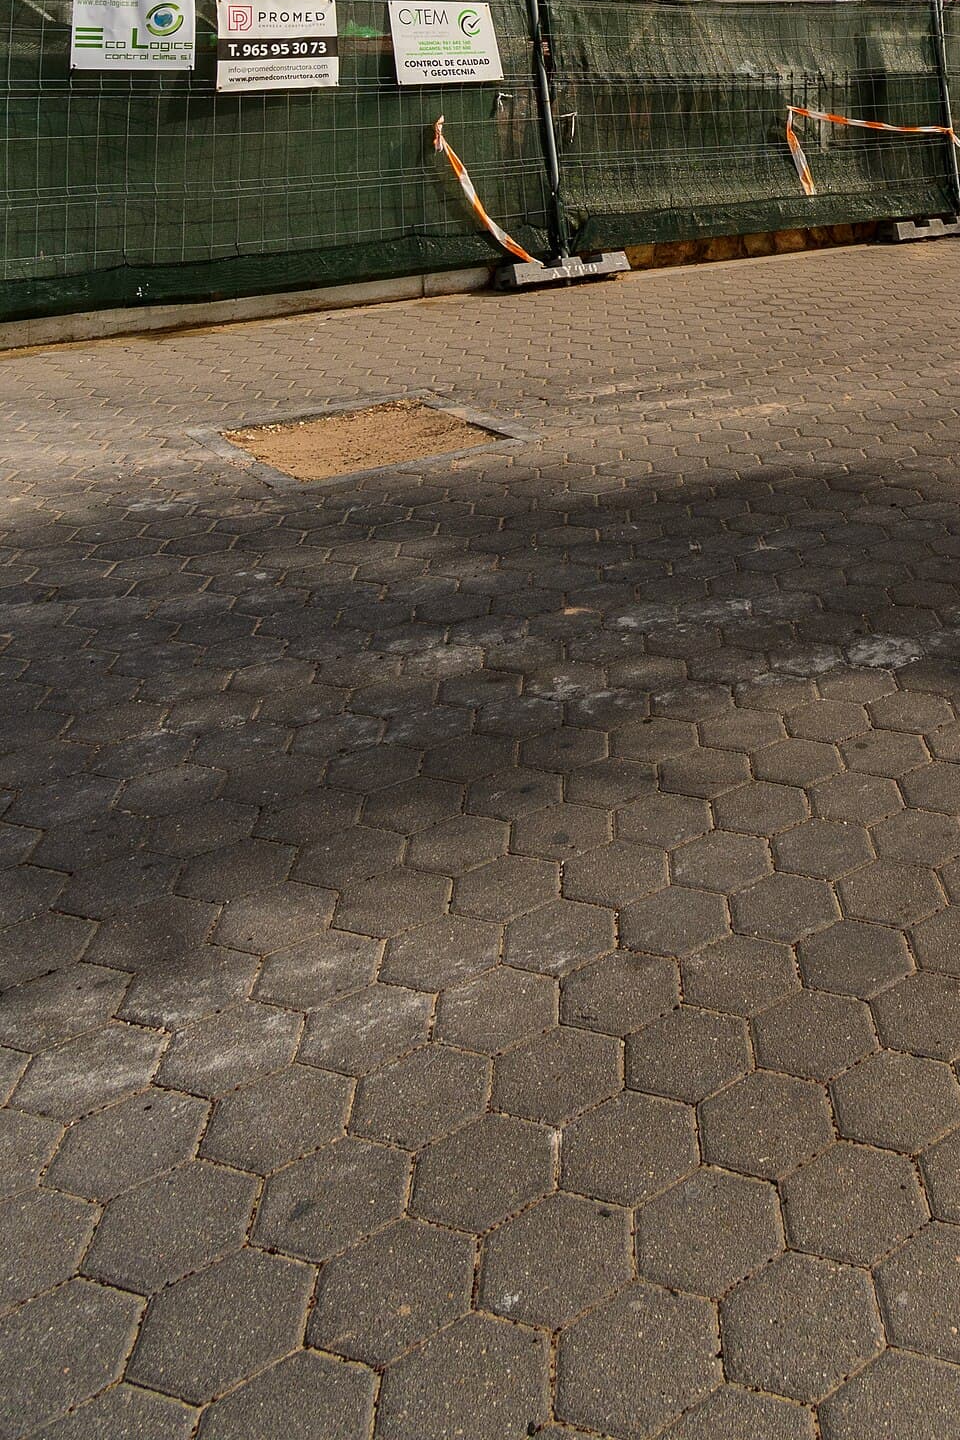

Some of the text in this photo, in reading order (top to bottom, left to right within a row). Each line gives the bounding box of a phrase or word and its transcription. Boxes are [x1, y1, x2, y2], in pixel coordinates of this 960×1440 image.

[258, 12, 325, 22] PROMED
[75, 27, 193, 51] Eco Logics
[228, 42, 327, 57] T. 965 95 30 73
[228, 63, 328, 74] info@promedconstructora.com
[404, 58, 490, 68] CONTROL DE CALIDAD
[228, 72, 330, 83] www.promedconstructora.com
[431, 68, 476, 77] GEOTECNIA
